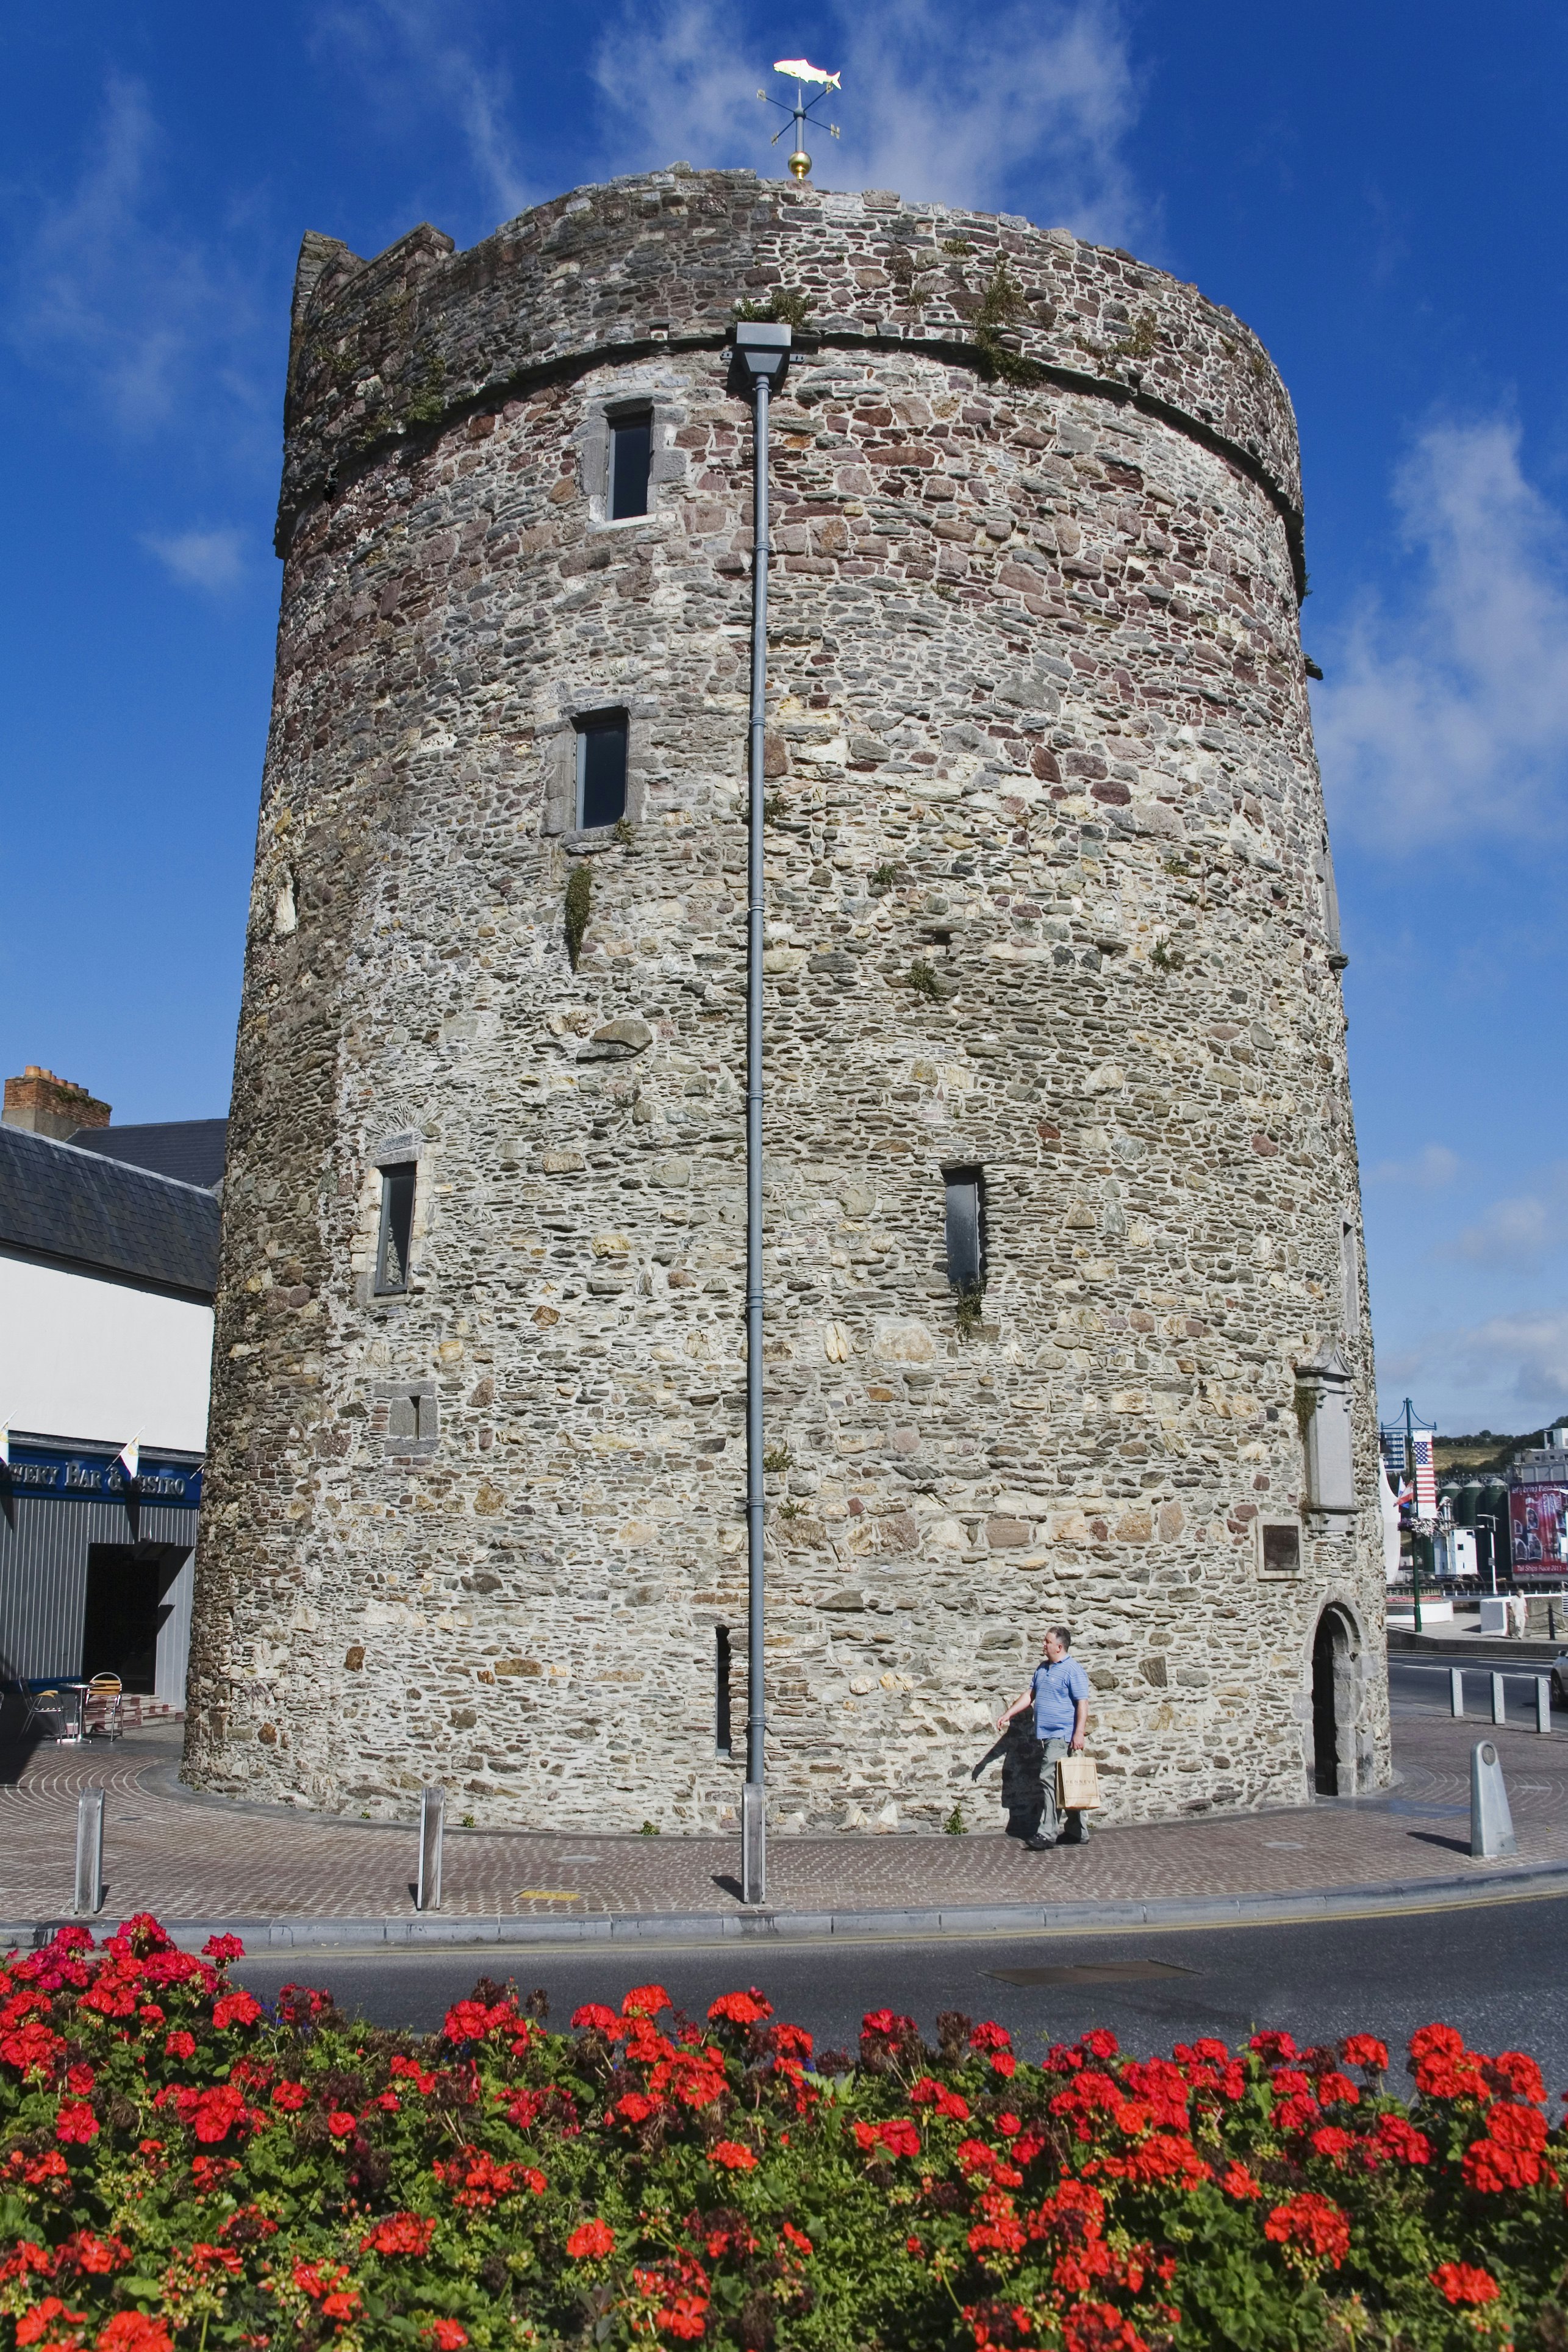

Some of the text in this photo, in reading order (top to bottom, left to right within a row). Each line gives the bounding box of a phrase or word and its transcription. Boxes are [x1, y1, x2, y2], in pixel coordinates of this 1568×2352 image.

[0, 1461, 60, 1485] WERY
[65, 1461, 102, 1488] BAR
[107, 1466, 124, 1491] &
[1523, 1485, 1538, 1494] bring
